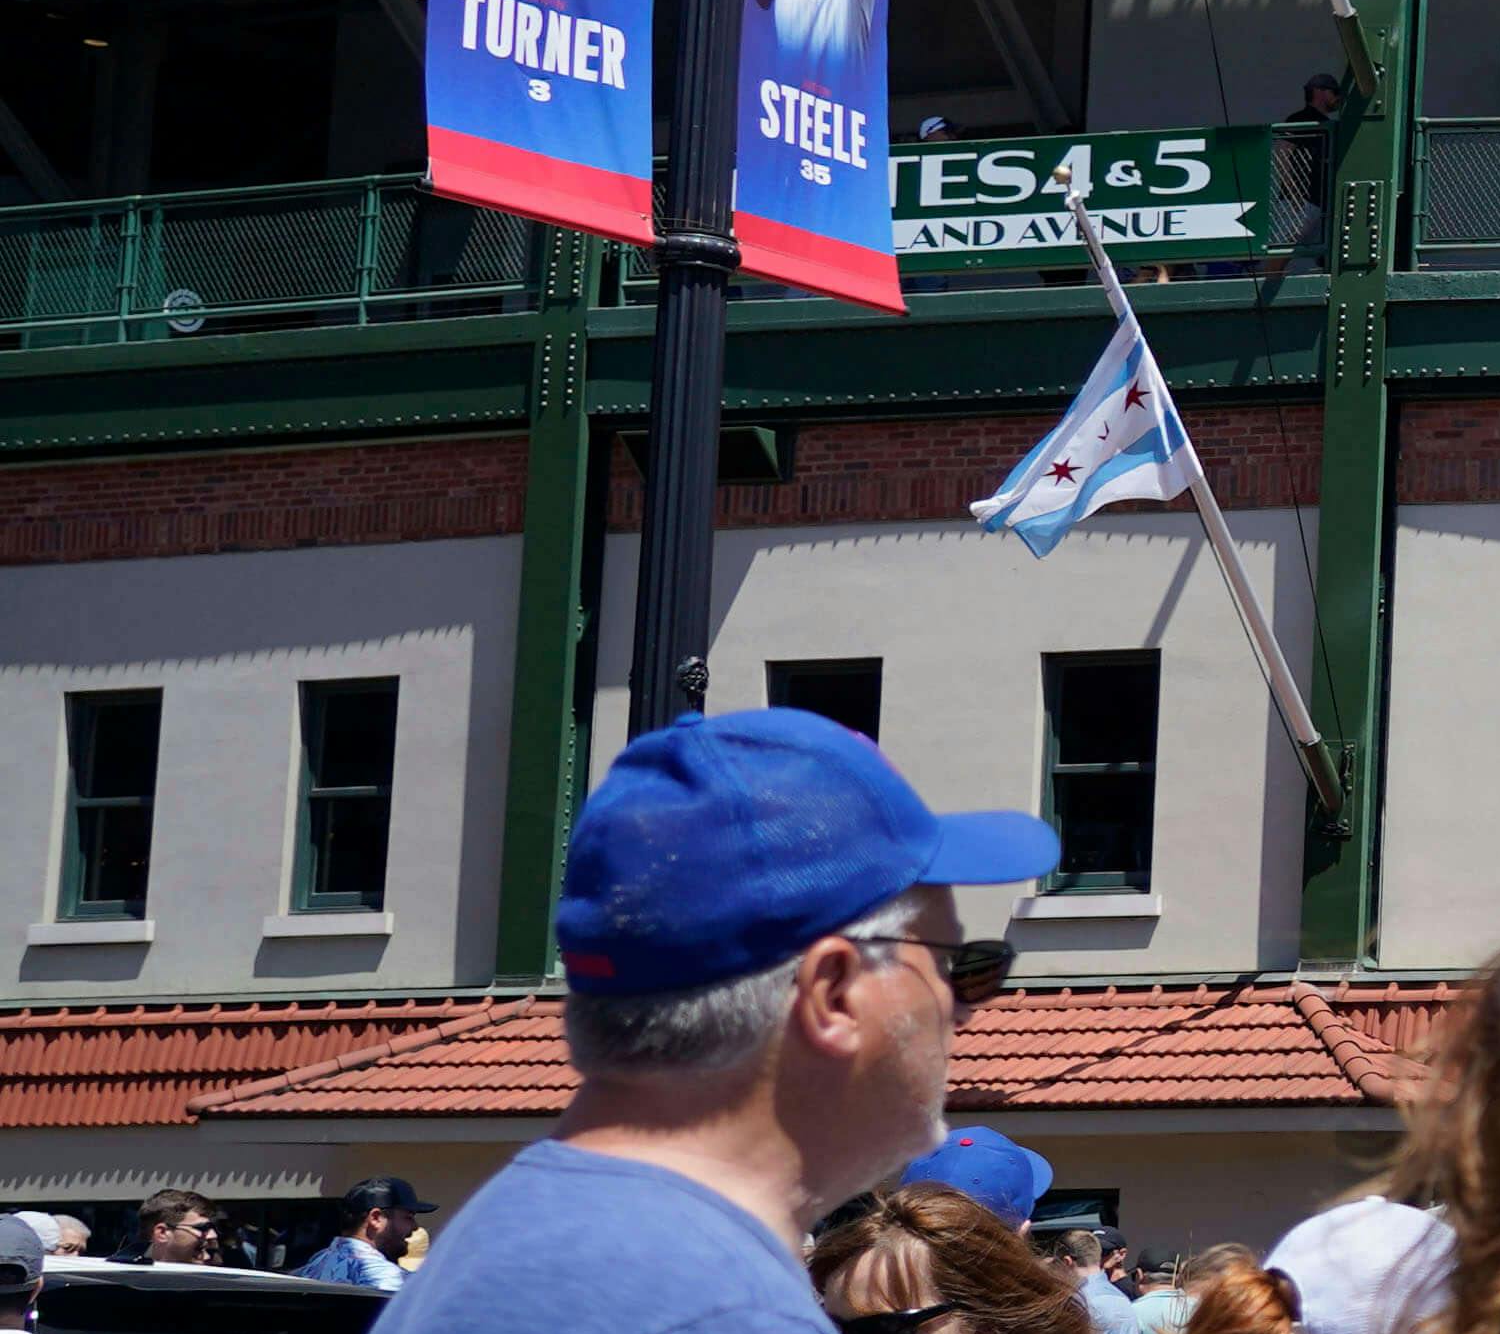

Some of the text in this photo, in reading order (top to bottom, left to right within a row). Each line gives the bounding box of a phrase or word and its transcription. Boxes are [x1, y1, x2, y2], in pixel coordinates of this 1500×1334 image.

[528, 79, 551, 102] 3
[760, 79, 867, 170] STEELE
[800, 158, 831, 186] 35
[1041, 145, 1093, 200] 4
[1105, 160, 1142, 188] &
[1149, 138, 1211, 195] 5
